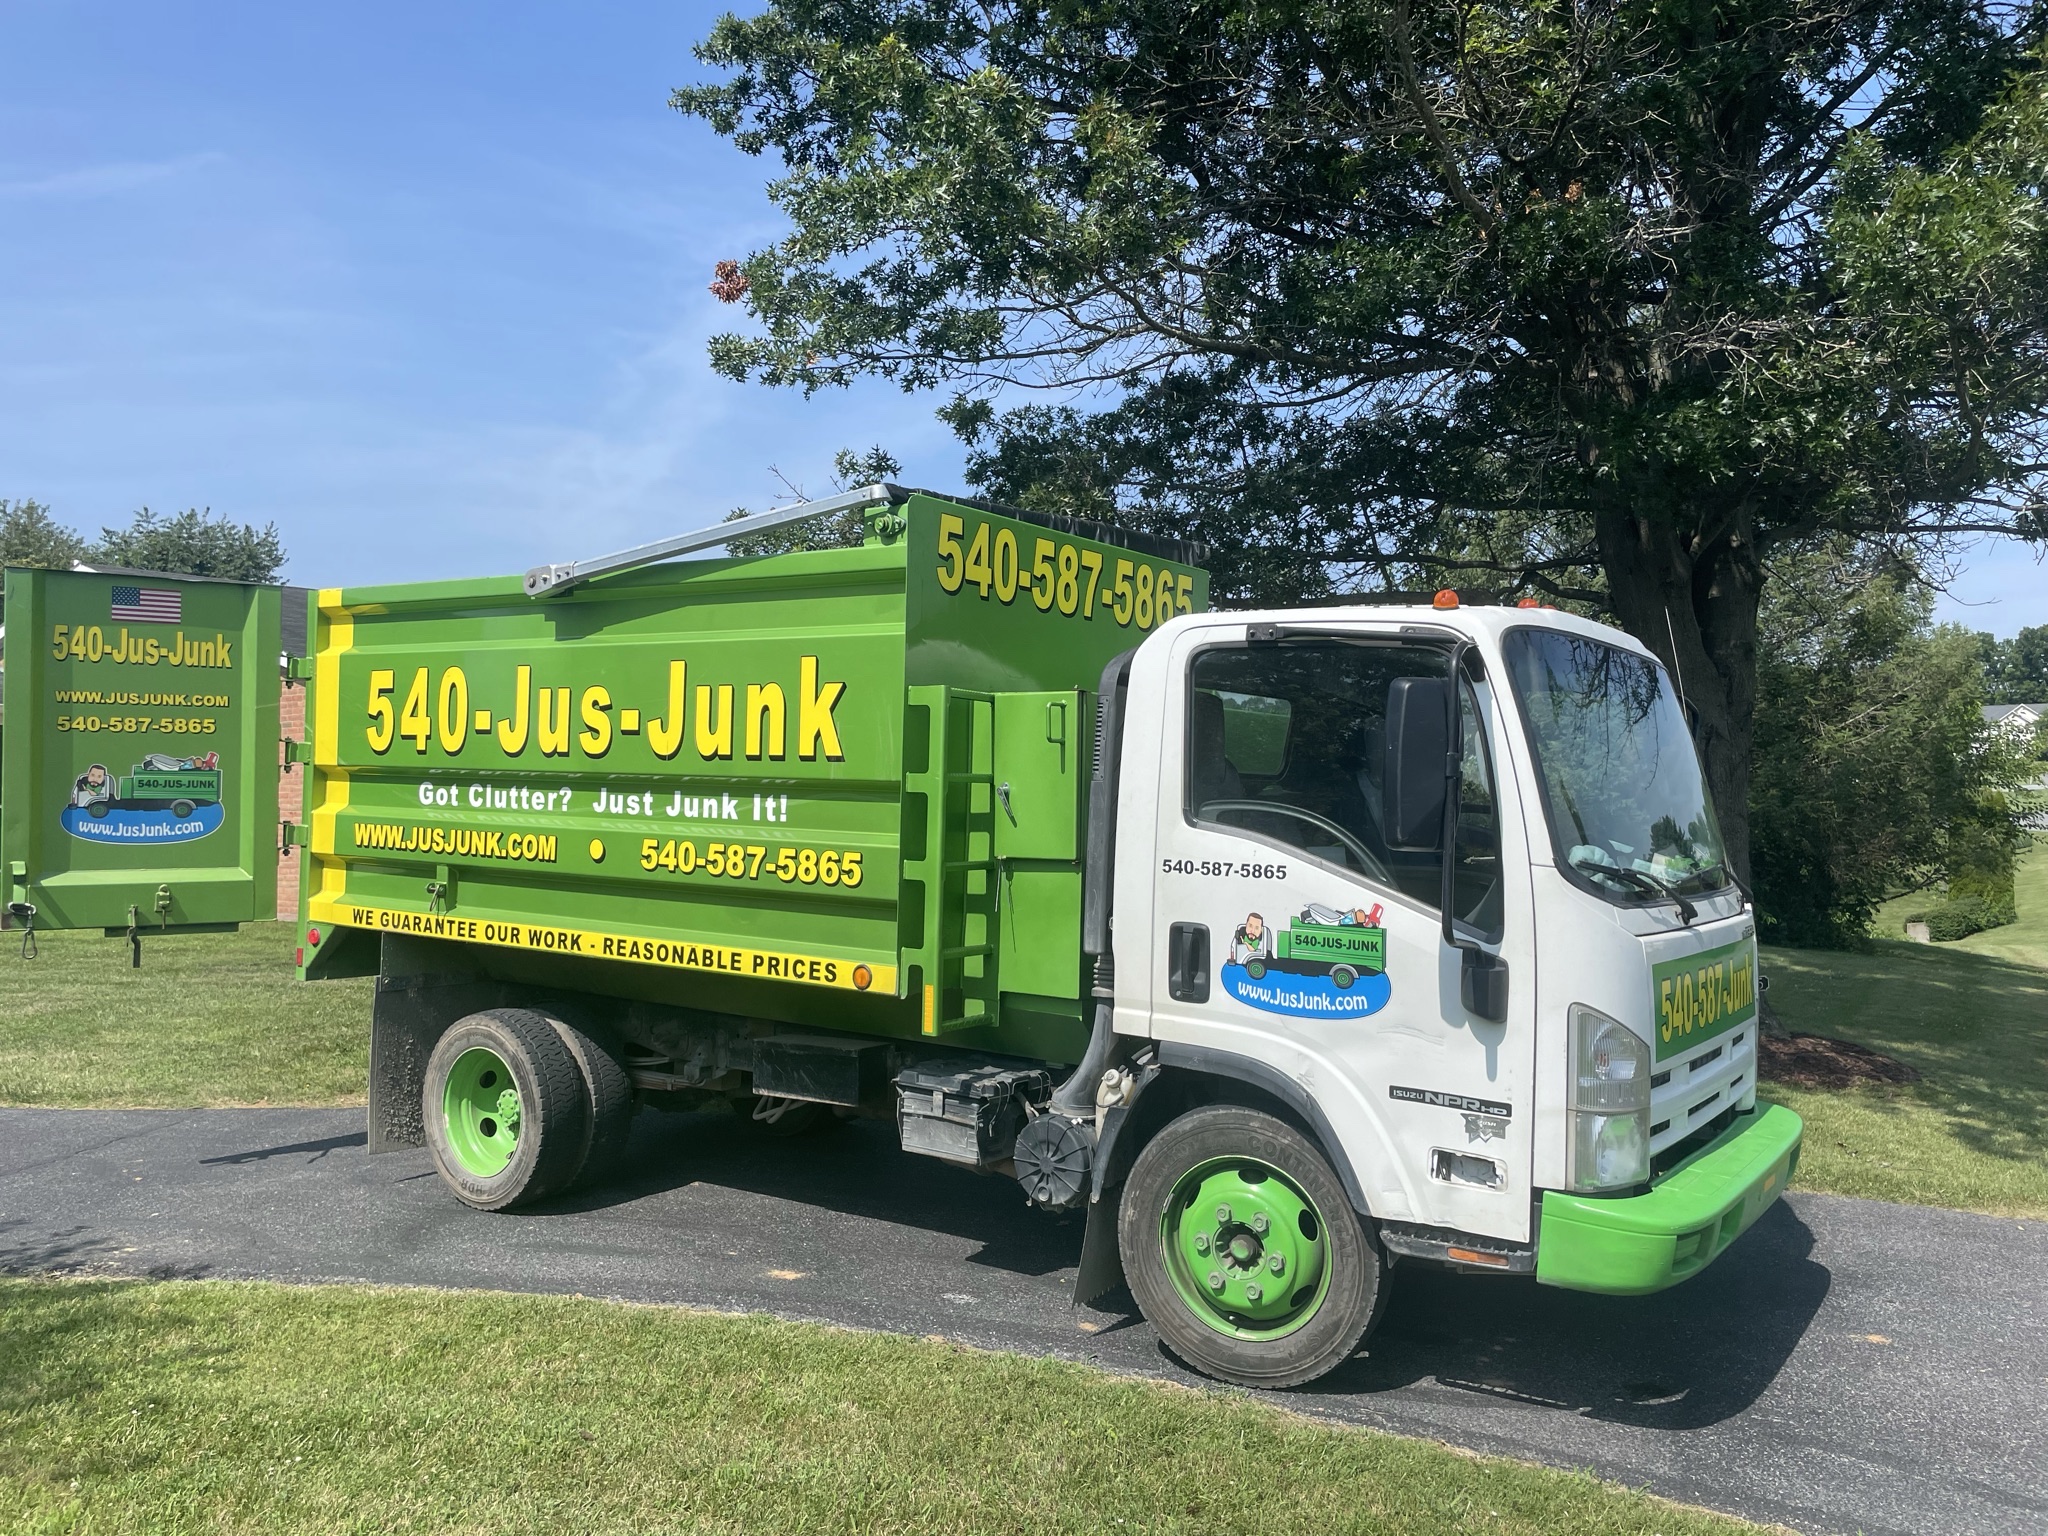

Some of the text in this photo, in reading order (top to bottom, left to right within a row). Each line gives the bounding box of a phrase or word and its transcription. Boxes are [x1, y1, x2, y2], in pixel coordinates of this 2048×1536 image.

[936, 512, 1193, 630] 540-587-5865
[52, 624, 233, 669] 540-Jus-Junk
[55, 690, 229, 707] WWW.JUSJUNK.COM
[366, 655, 847, 763] 540-Jus-Junk
[57, 716, 217, 734] 540-587-5865
[137, 778, 215, 790] 540-JUS-JUNK
[418, 782, 789, 823] Got Clutter? Just Junk It!
[78, 819, 204, 837] www.JusJunk.com
[354, 823, 864, 889] WWW.JUSJUNK.COM 540-587-5865
[1162, 859, 1287, 880] 540-587-5865
[352, 909, 374, 927] WE
[380, 912, 477, 939] GUARANTEE
[485, 923, 520, 943] OUR
[527, 928, 582, 952] WORK
[603, 937, 742, 972] REASONABLE
[752, 955, 838, 984] PRICES
[1295, 935, 1379, 952] 540-JUS-JUNK
[1238, 982, 1368, 1010] www.JusJunk.com
[1661, 953, 1753, 1043] 540-587-Junk
[1393, 1090, 1423, 1099] ISUZU
